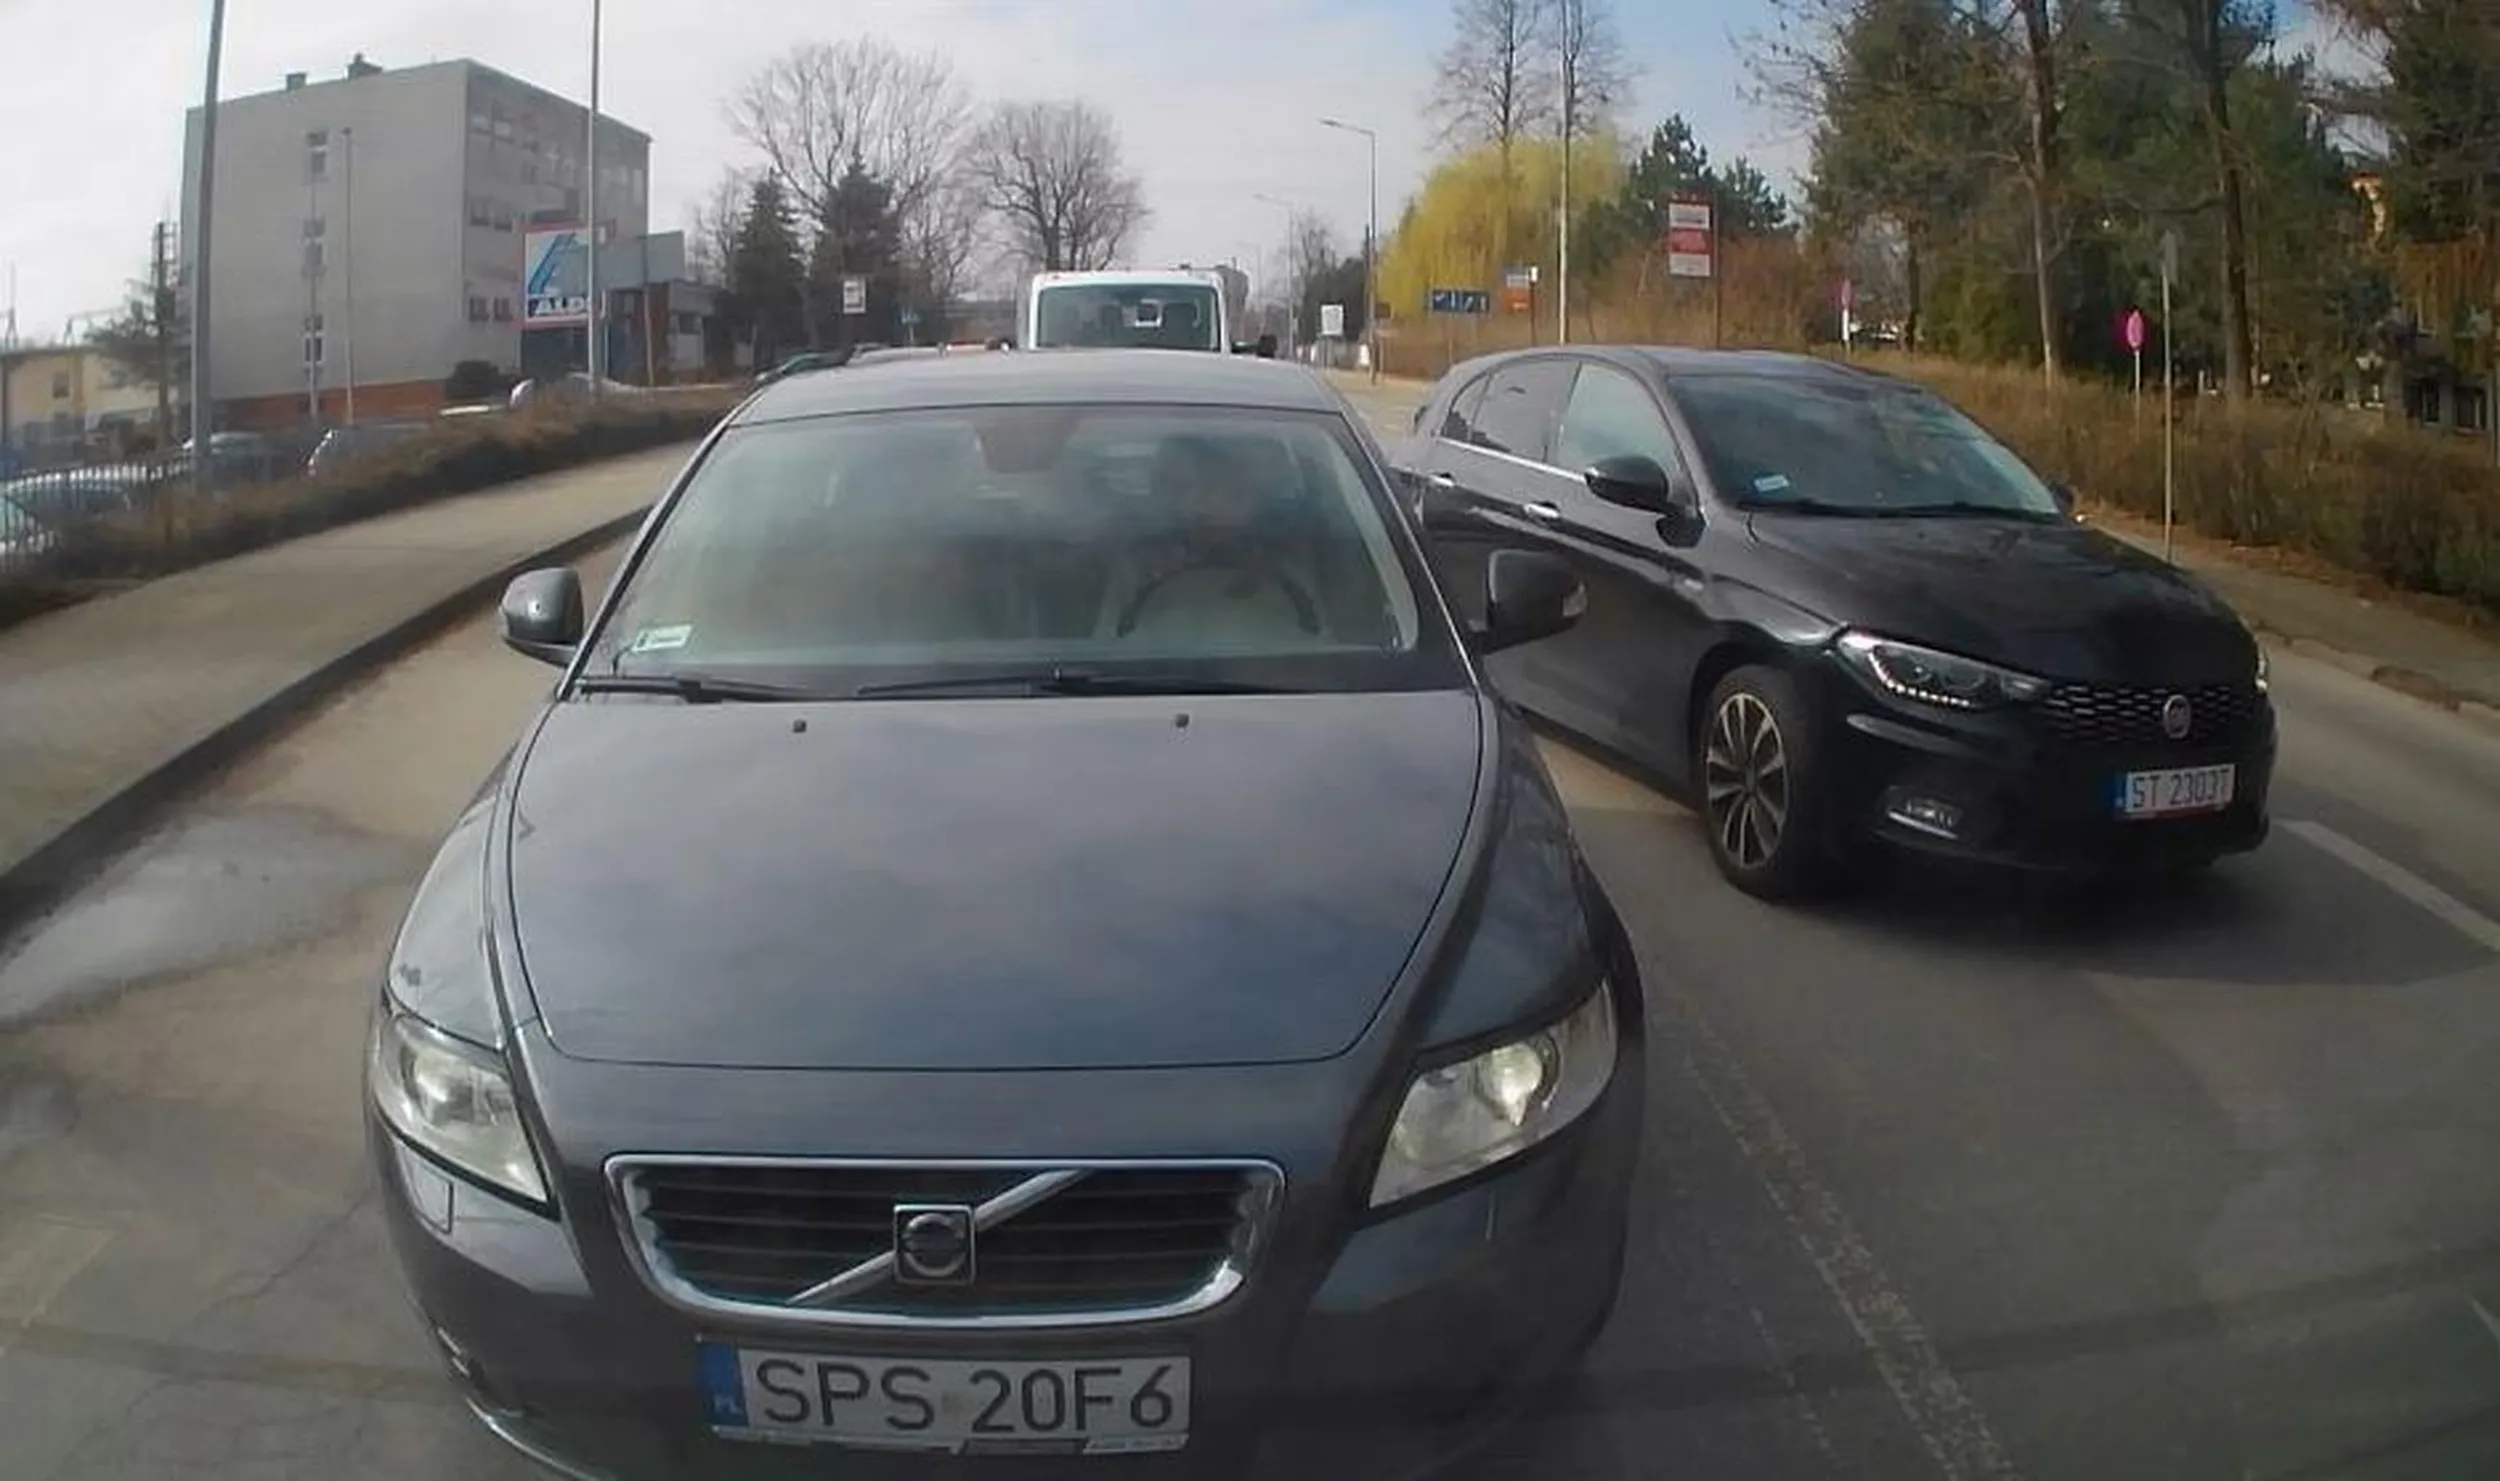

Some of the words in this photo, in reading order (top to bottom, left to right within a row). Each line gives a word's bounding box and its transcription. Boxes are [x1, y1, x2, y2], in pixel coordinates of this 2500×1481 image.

[535, 296, 592, 315] ALD
[2132, 774, 2162, 809] ST
[757, 1359, 935, 1430] SPS
[969, 1364, 1172, 1433] 20F6
